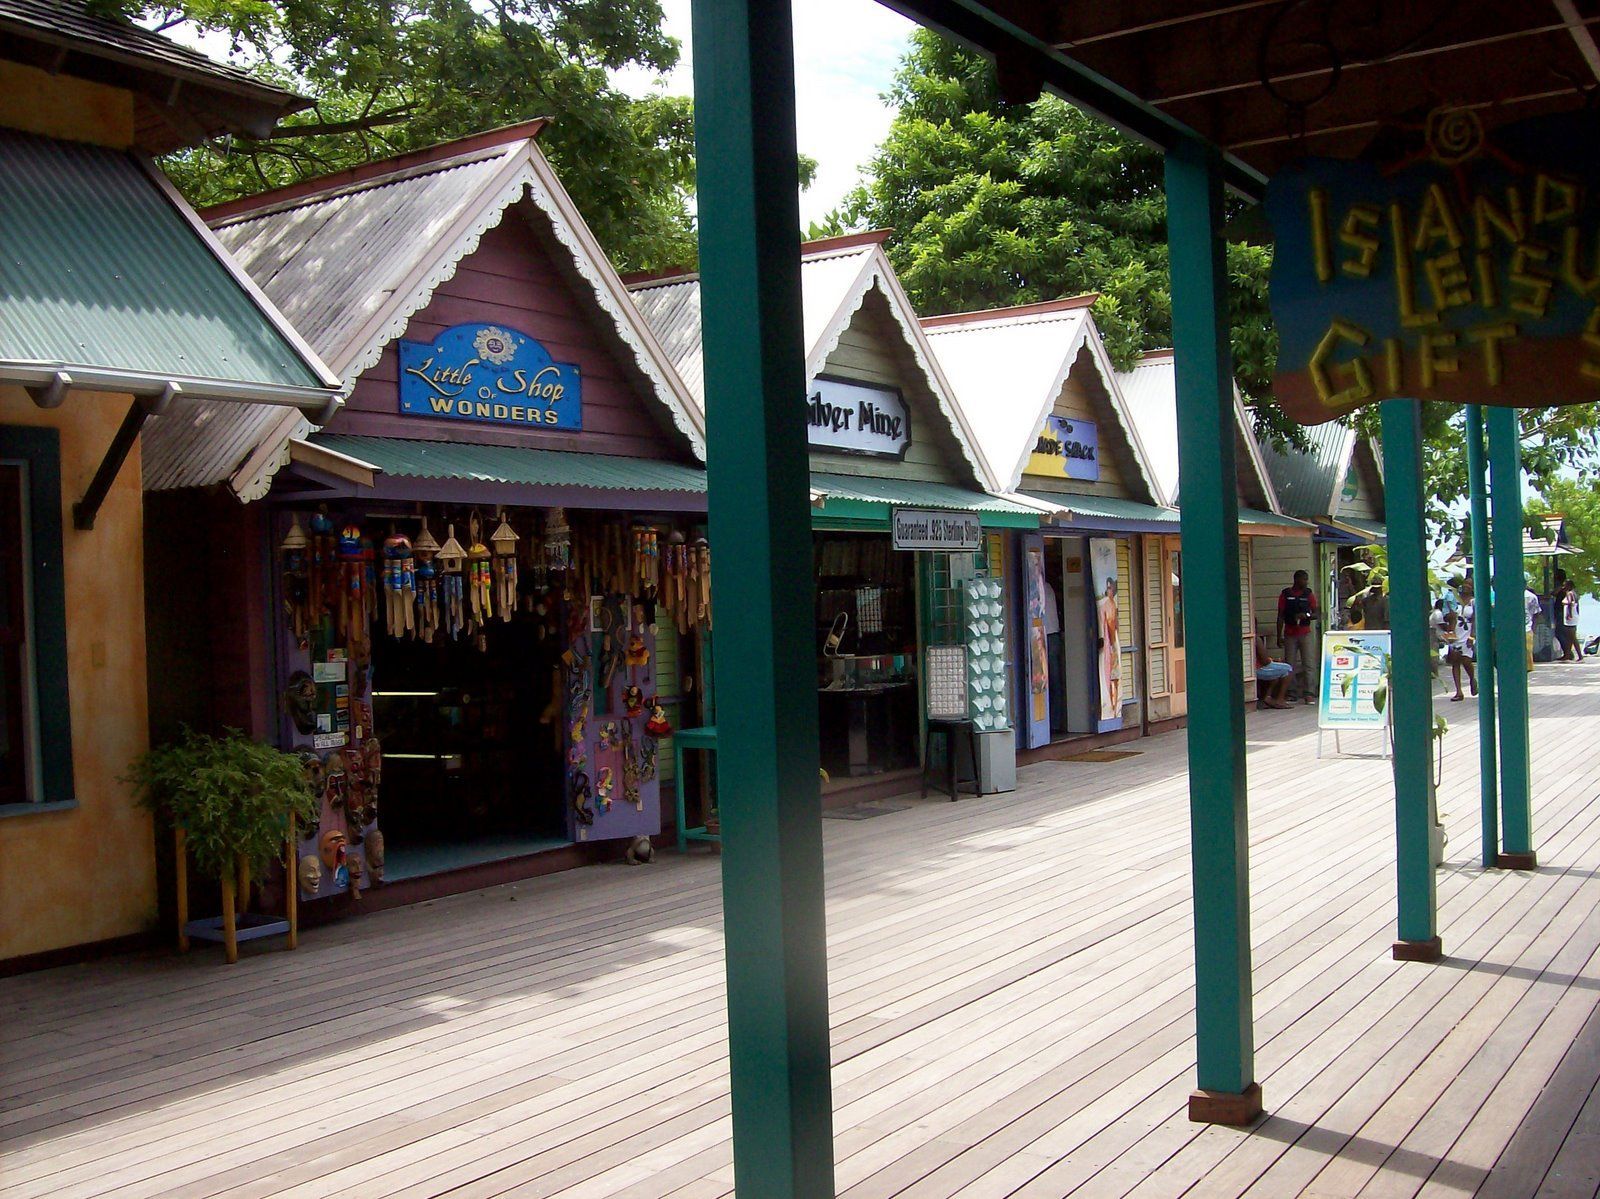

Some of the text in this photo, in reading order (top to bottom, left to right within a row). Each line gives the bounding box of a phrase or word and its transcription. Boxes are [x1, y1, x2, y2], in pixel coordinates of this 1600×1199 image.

[1310, 174, 1578, 284] ISLAND
[406, 357, 564, 406] Little Shop
[1309, 322, 1517, 406] GIFT
[430, 397, 559, 424] WONDERS
[858, 400, 903, 440] Mine
[1064, 440, 1096, 461] SHACK
[896, 517, 979, 546] Guaranteed .925 Sterling Silver
